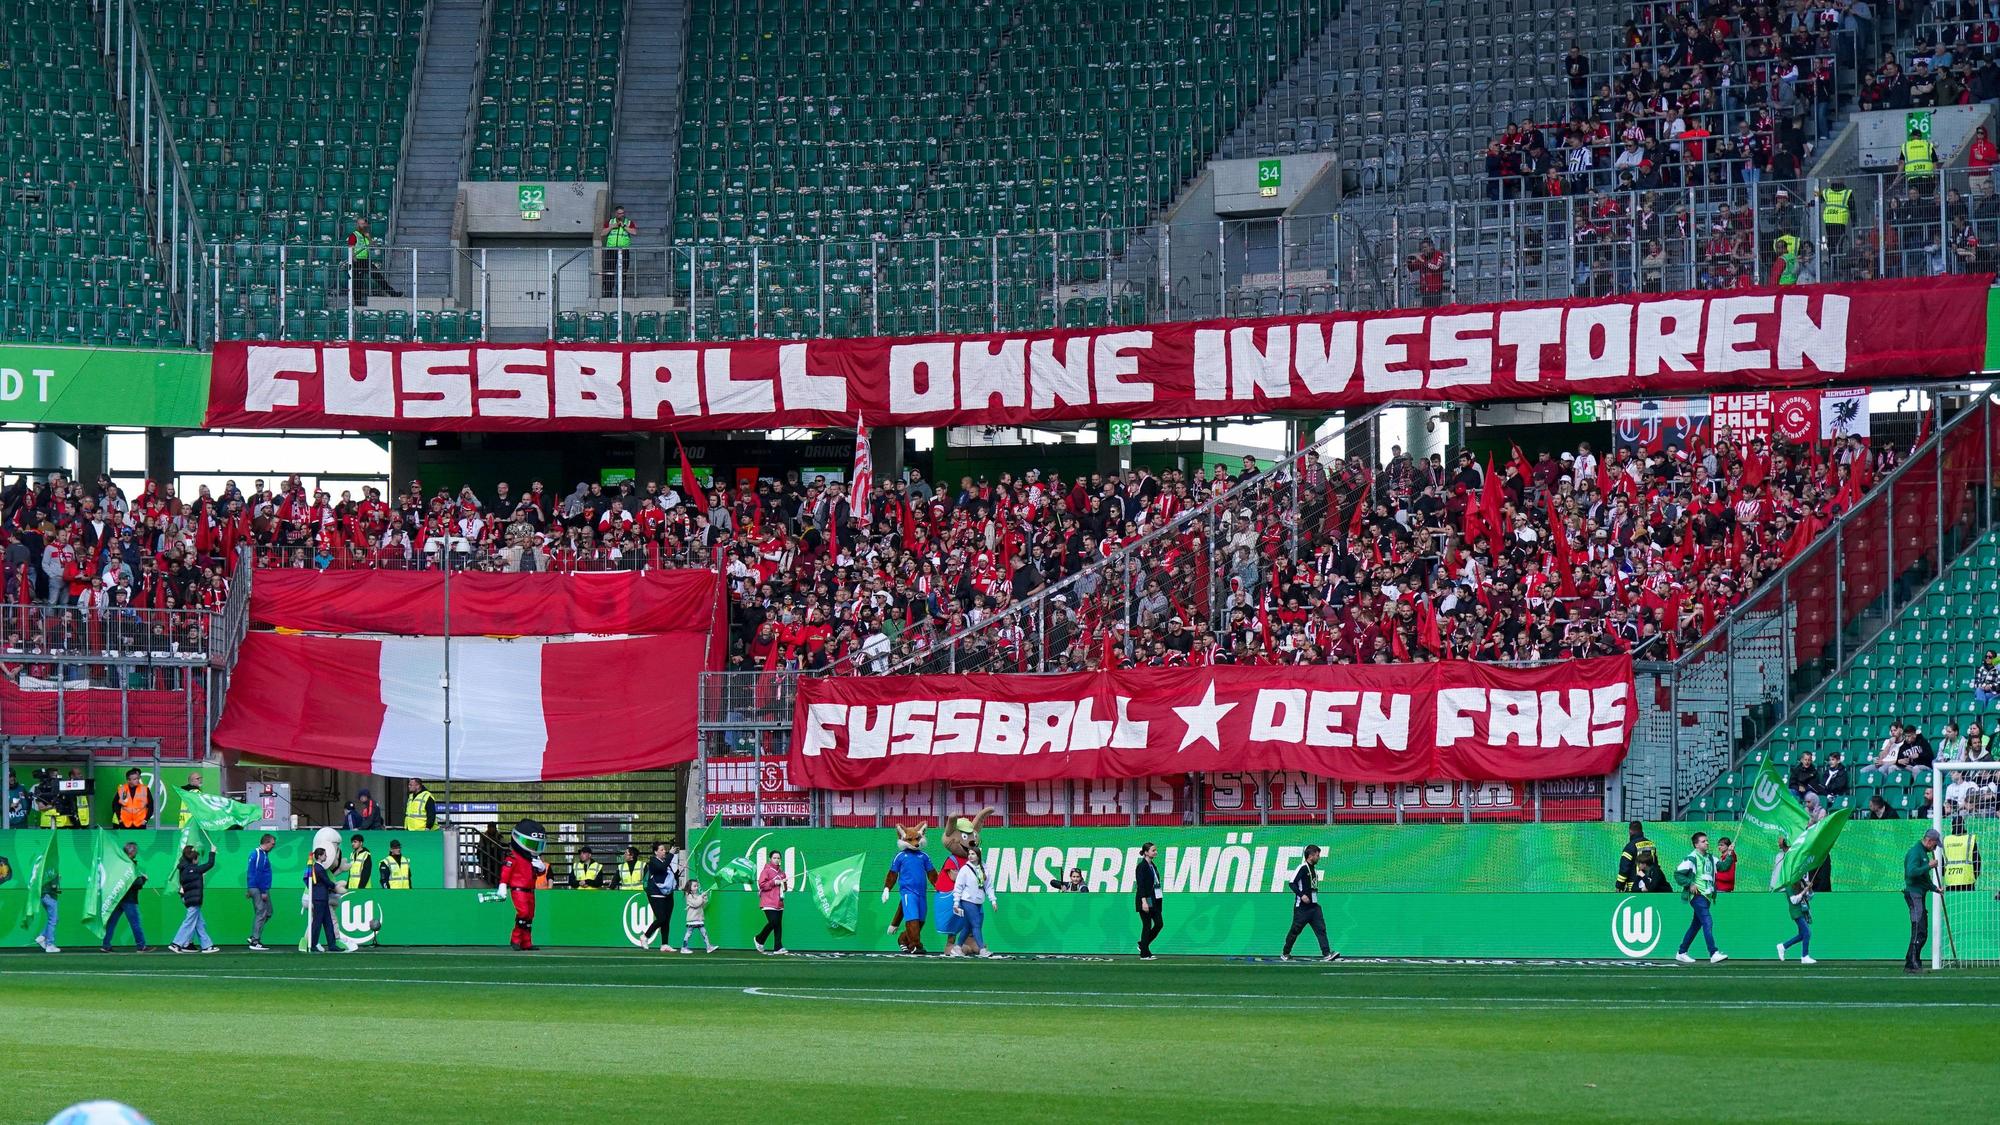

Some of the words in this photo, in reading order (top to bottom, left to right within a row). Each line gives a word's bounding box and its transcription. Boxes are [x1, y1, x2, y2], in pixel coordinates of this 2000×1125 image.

[1909, 118, 1929, 133] 36
[1260, 166, 1279, 181] 34
[521, 190, 543, 204] 32
[245, 343, 847, 419] FUSSBALL
[889, 331, 1154, 414] OHNE
[1194, 295, 1850, 401] INVESTOREN
[0, 368, 54, 402] DT
[1573, 400, 1593, 416] 35
[1713, 392, 1770, 412] FUSS
[1676, 411, 1707, 440] 97
[1713, 411, 1769, 429] BALL
[1112, 424, 1130, 439] 33
[804, 445, 851, 458] DRINKS
[802, 695, 1150, 759] FUSSBALL
[1249, 688, 1411, 751] DEN
[1435, 682, 1629, 748] FANS
